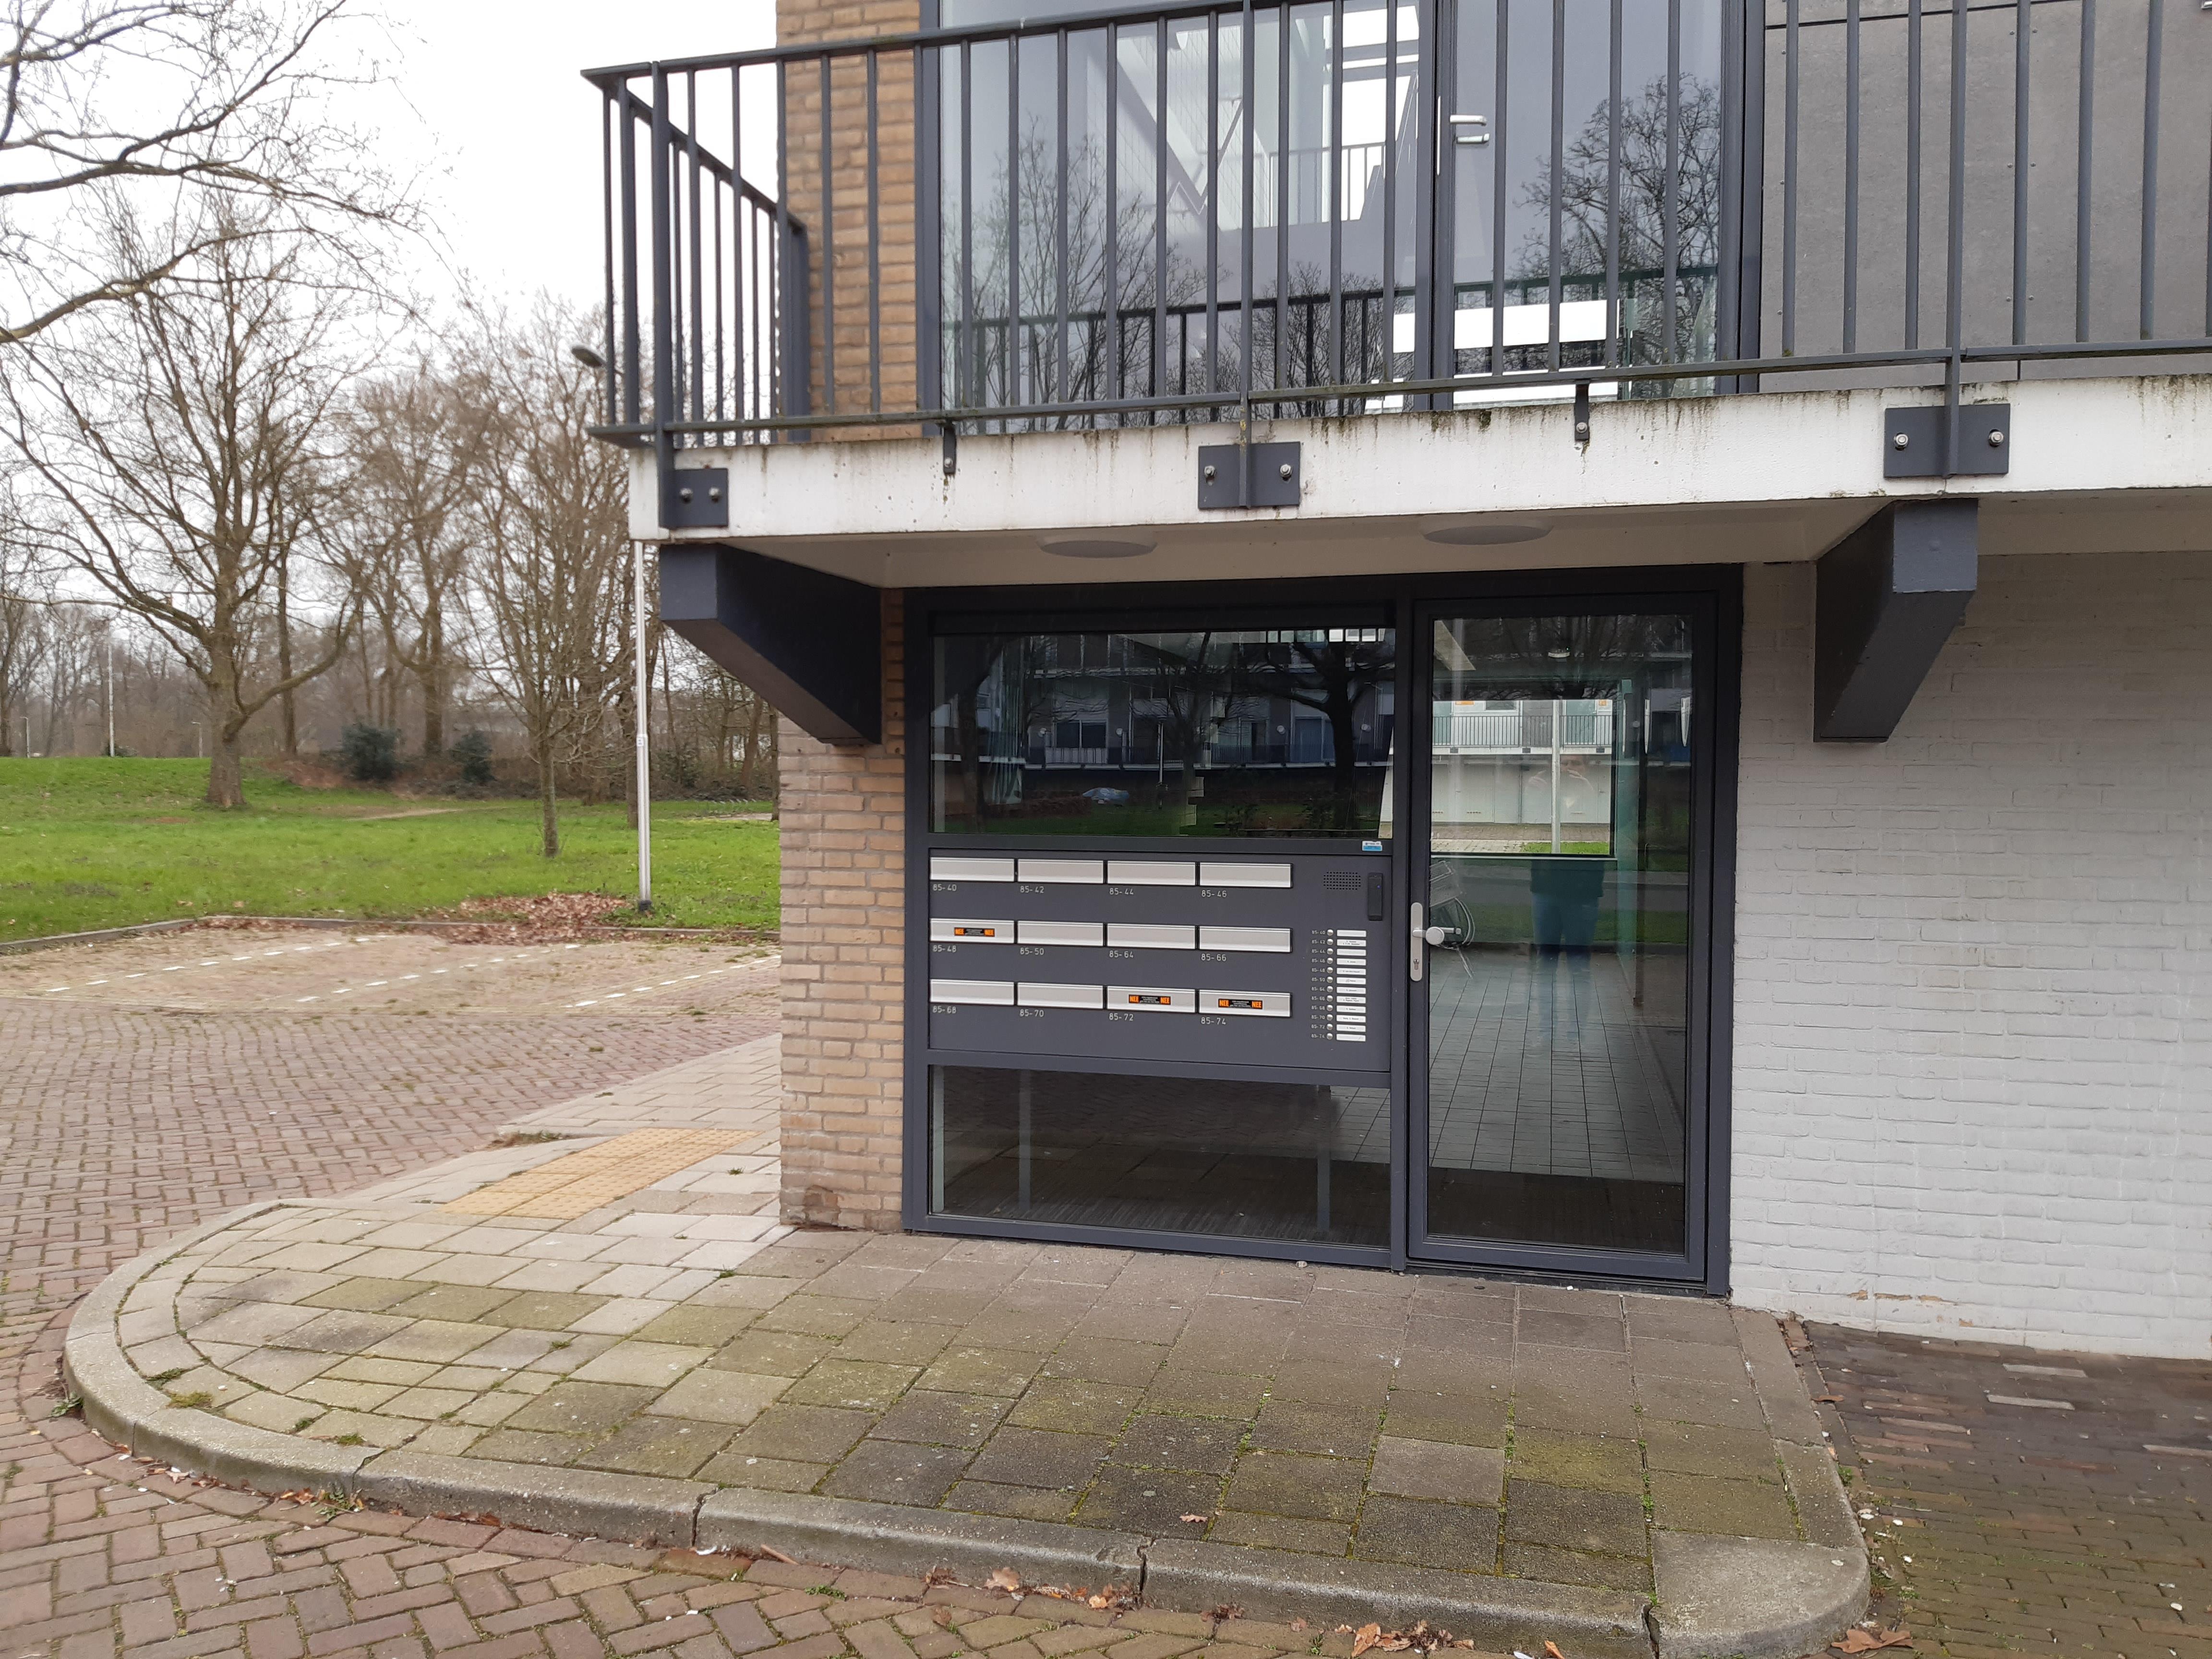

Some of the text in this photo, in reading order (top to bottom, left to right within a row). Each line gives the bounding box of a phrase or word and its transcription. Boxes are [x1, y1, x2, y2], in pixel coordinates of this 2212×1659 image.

[1202, 890, 1227, 898] 85-46
[933, 945, 957, 953] 85-48
[1020, 947, 1044, 955] 85-50
[1201, 953, 1226, 962] 85-66
[932, 1006, 957, 1014] 85-68
[1020, 1009, 1044, 1017] 85-70
[1109, 1012, 1133, 1021] 85-72
[1201, 1017, 1226, 1025] 85-74
